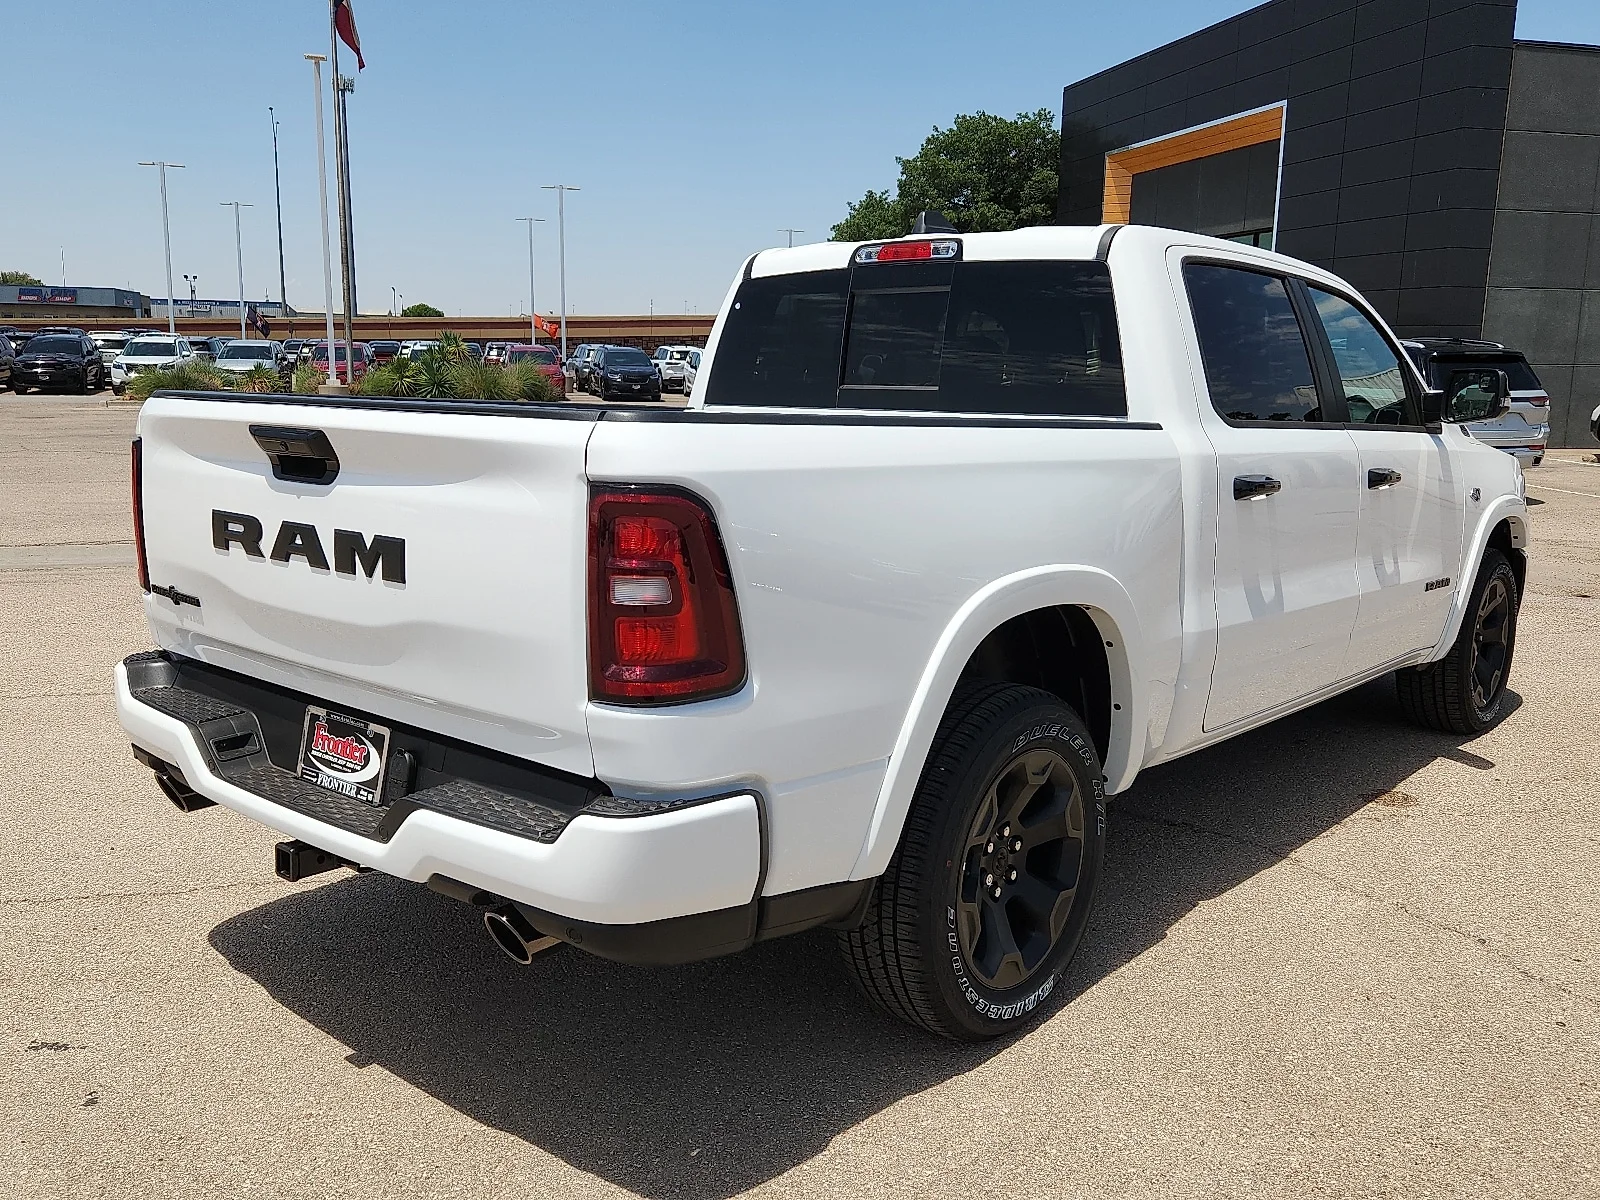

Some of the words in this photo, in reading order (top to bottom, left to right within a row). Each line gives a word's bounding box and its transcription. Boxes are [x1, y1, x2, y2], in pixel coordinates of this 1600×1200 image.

[212, 509, 406, 584] RAM
[312, 721, 368, 765] Frontier
[1011, 723, 1094, 766] DUELER
[317, 773, 357, 798] FRONTIER
[947, 905, 1054, 1020] BRIDGESTONE
